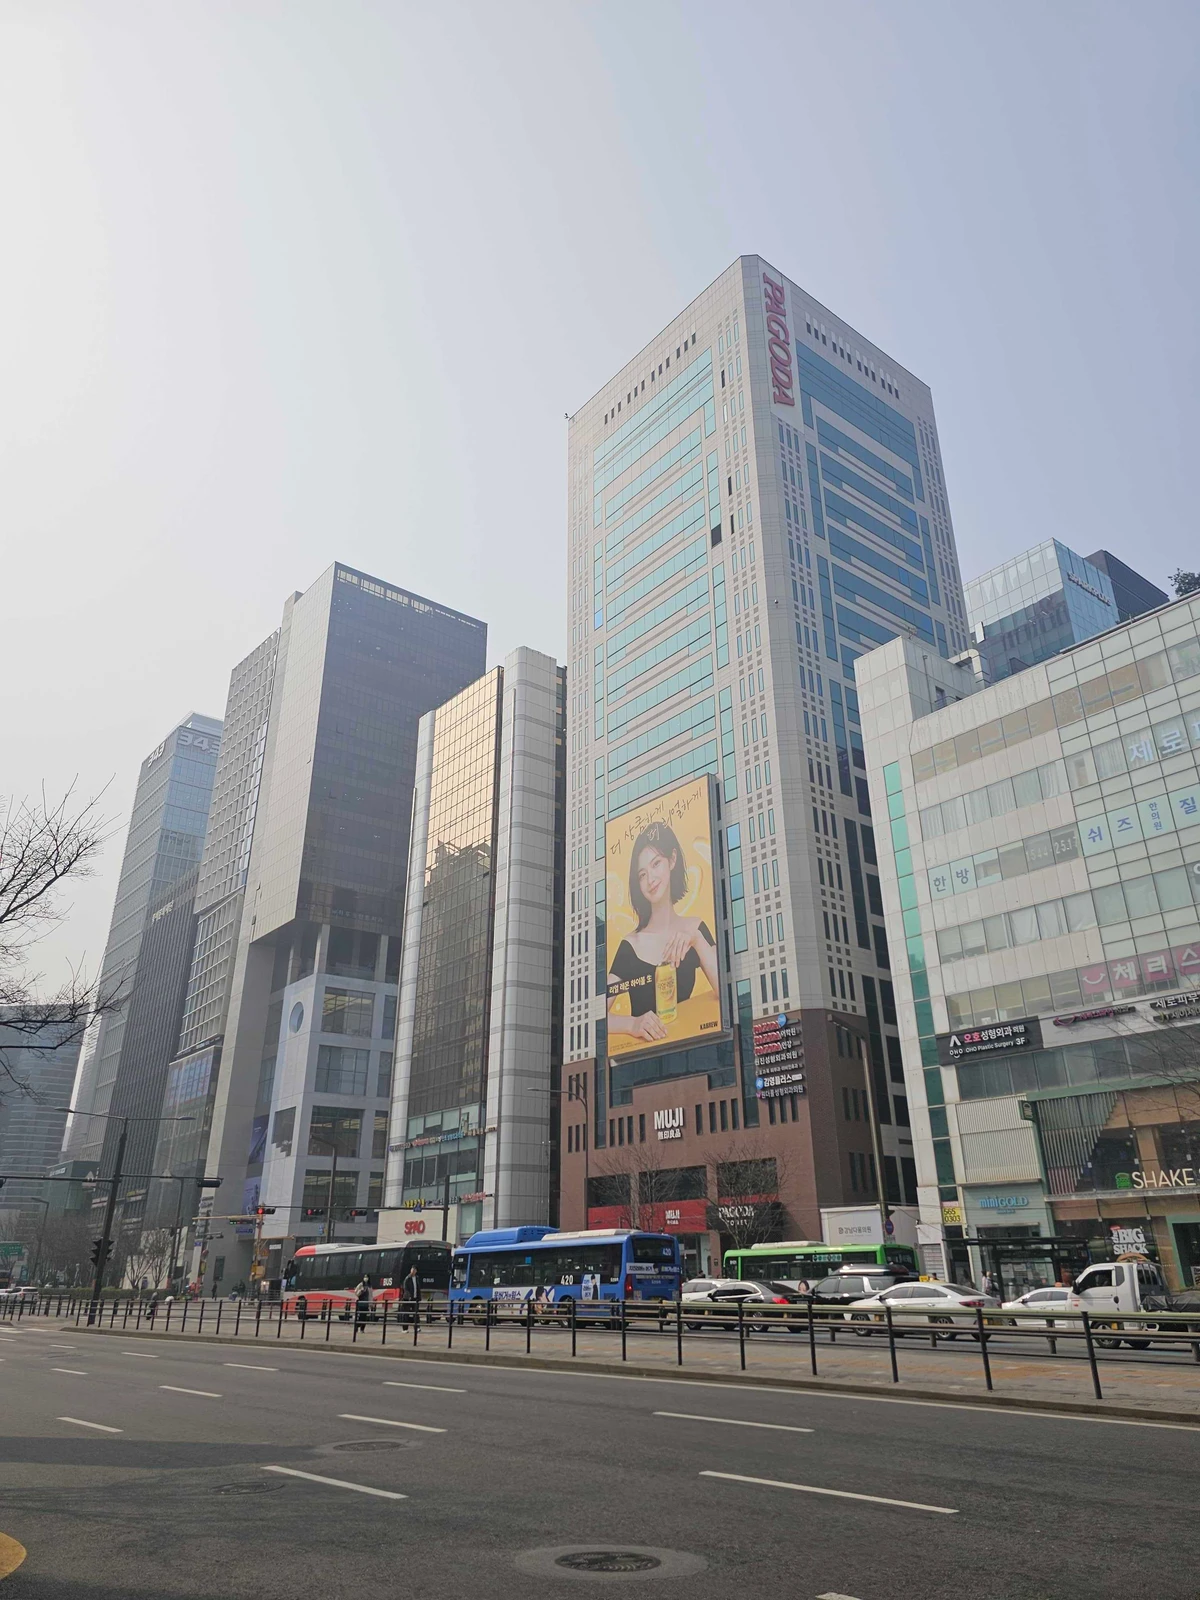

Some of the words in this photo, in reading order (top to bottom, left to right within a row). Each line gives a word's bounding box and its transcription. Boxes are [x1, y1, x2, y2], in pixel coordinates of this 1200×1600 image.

[763, 272, 795, 406] PAGODA
[177, 732, 220, 755] 343
[1178, 796, 1198, 815] 질
[1088, 816, 1134, 843] 쉬즈
[933, 868, 970, 893] 한방
[994, 1040, 1014, 1048] Surgery
[1015, 1037, 1026, 1046] 3F
[653, 1107, 684, 1130] MUJI
[1131, 1168, 1197, 1189] SHAKE
[404, 1220, 425, 1235] SPAO
[1117, 1228, 1145, 1243] BIG
[662, 1248, 672, 1256] 420
[1113, 1243, 1149, 1255] SHACK
[560, 1274, 574, 1286] 420
